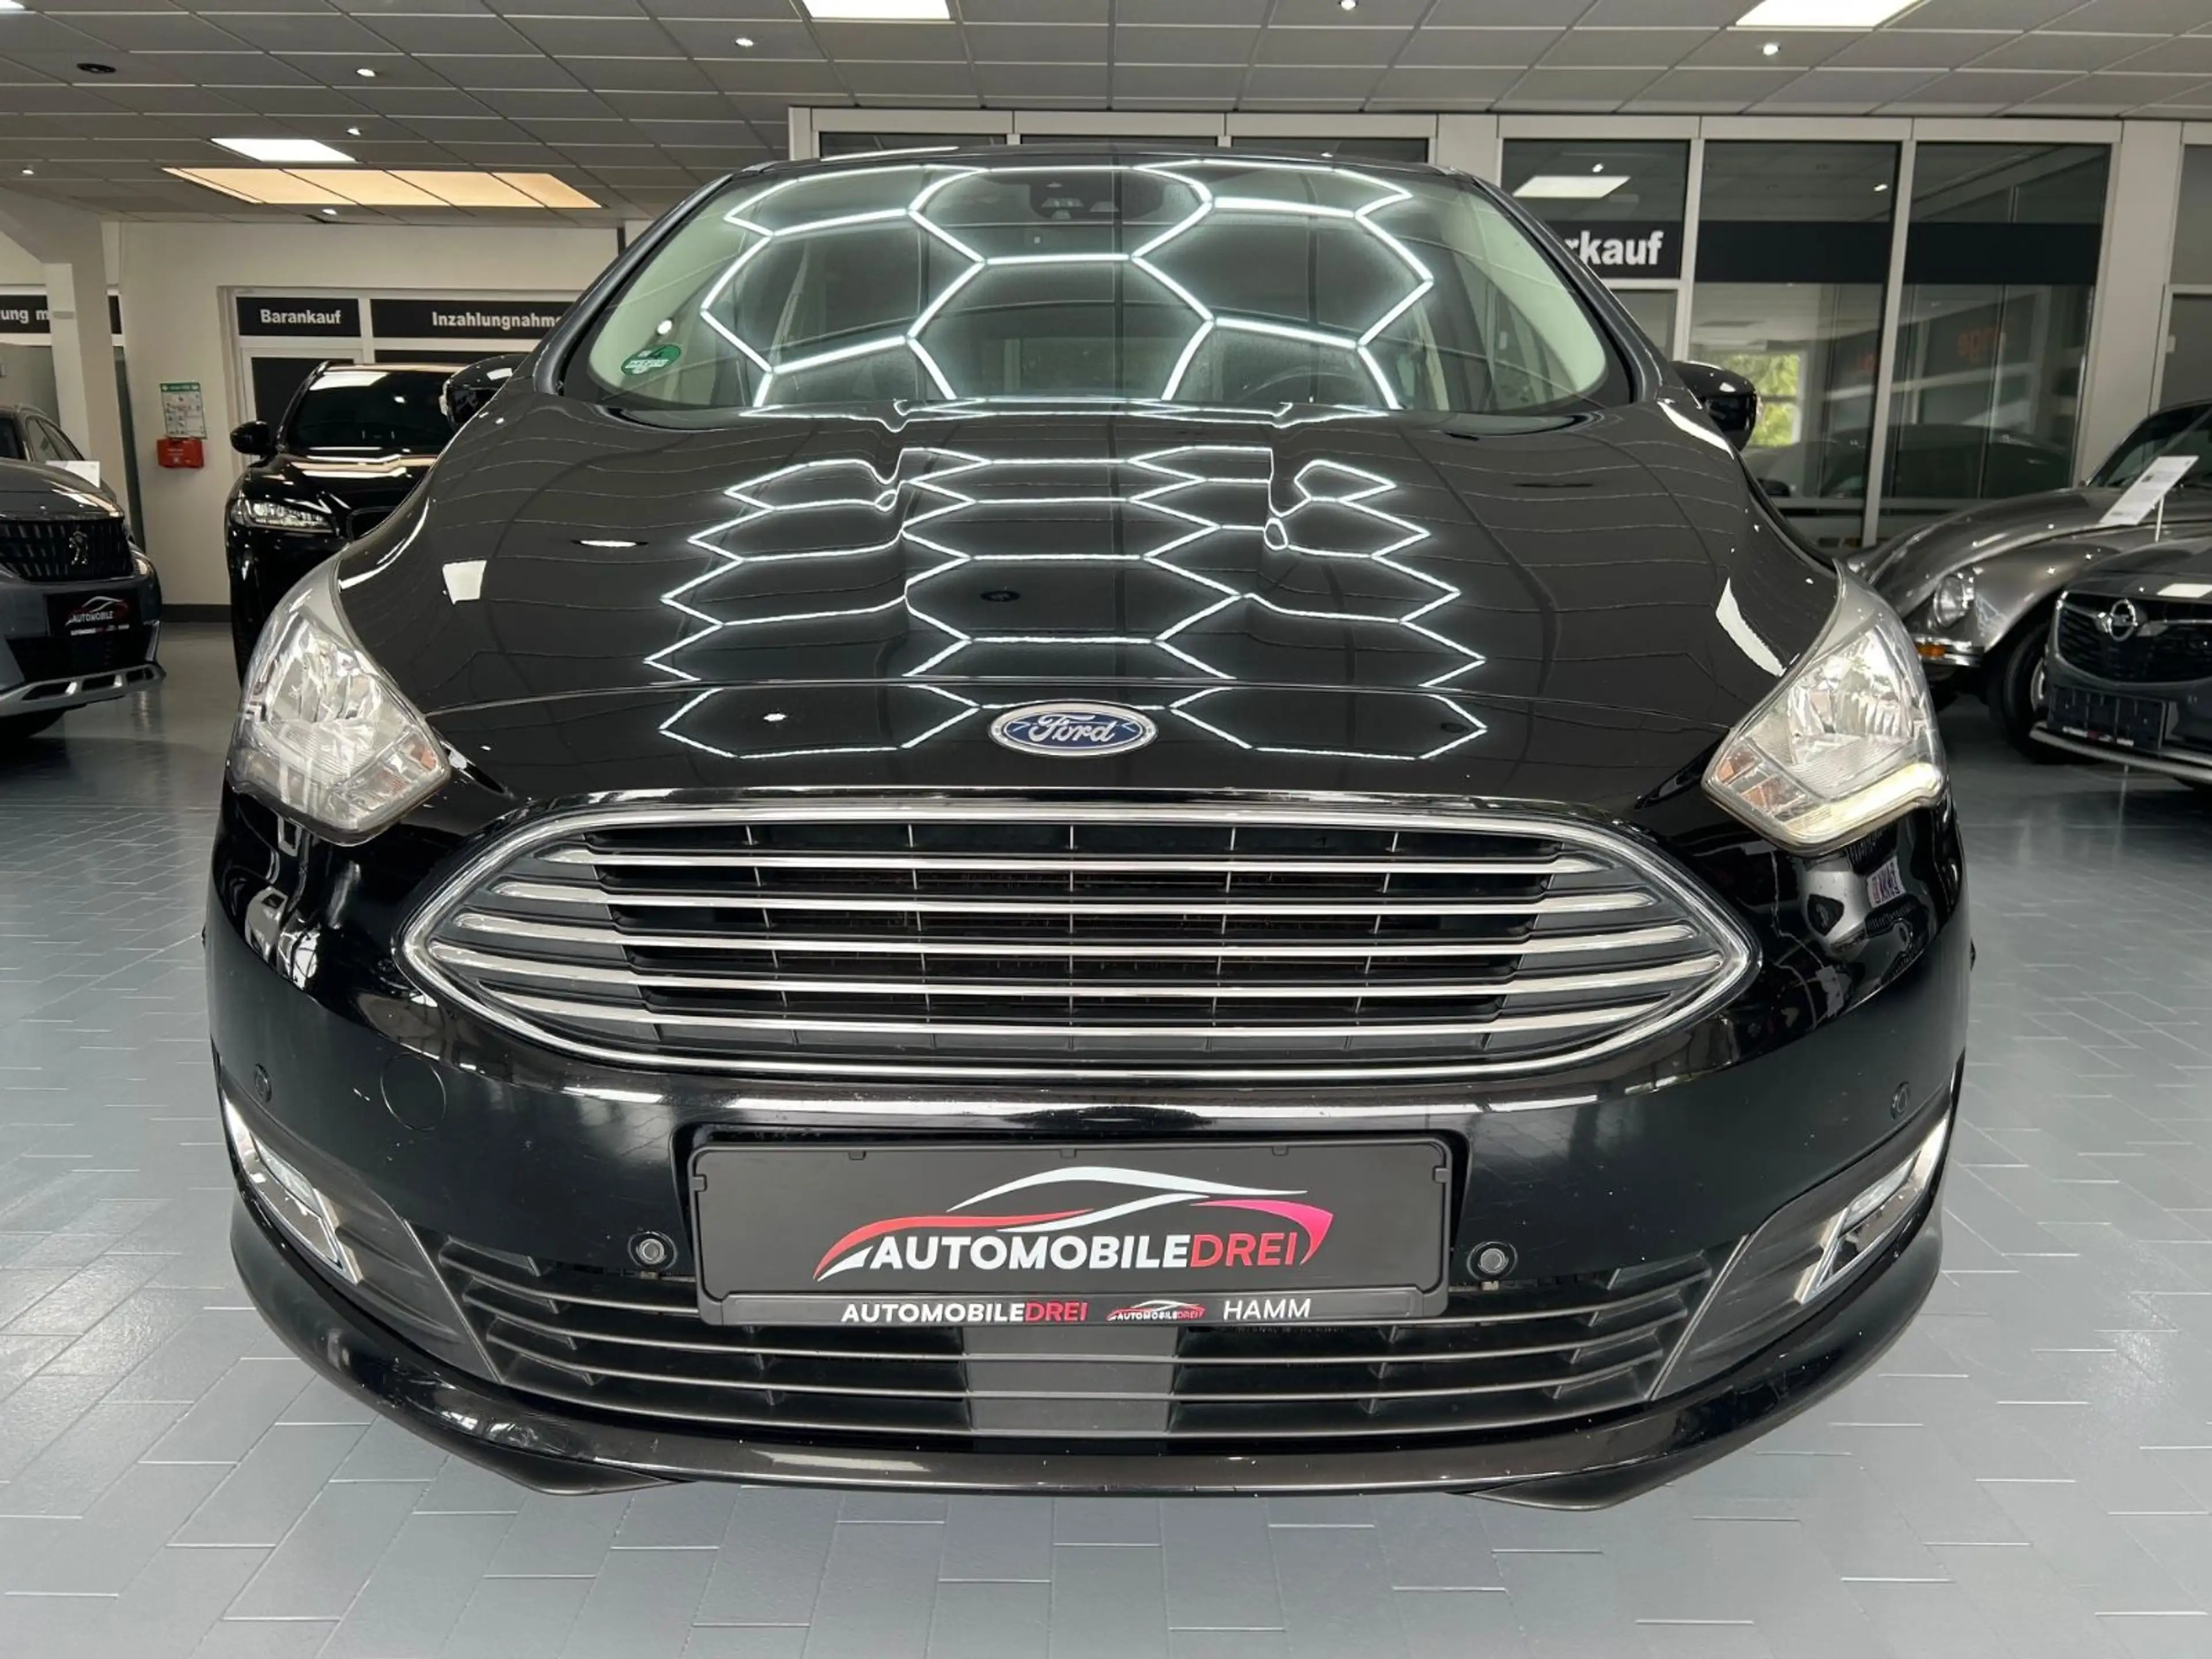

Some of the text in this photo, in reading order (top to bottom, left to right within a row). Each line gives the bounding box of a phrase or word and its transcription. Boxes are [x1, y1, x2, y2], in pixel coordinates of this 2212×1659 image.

[260, 309, 341, 324] Barankauf
[433, 312, 562, 330] Inzahlungnahm
[1028, 714, 1118, 742] Ford
[870, 1232, 1298, 1270] AUTOMOBILEDREI
[841, 1301, 1089, 1323] AUTOMOBILEDREI
[1223, 1298, 1311, 1320] HAMM
